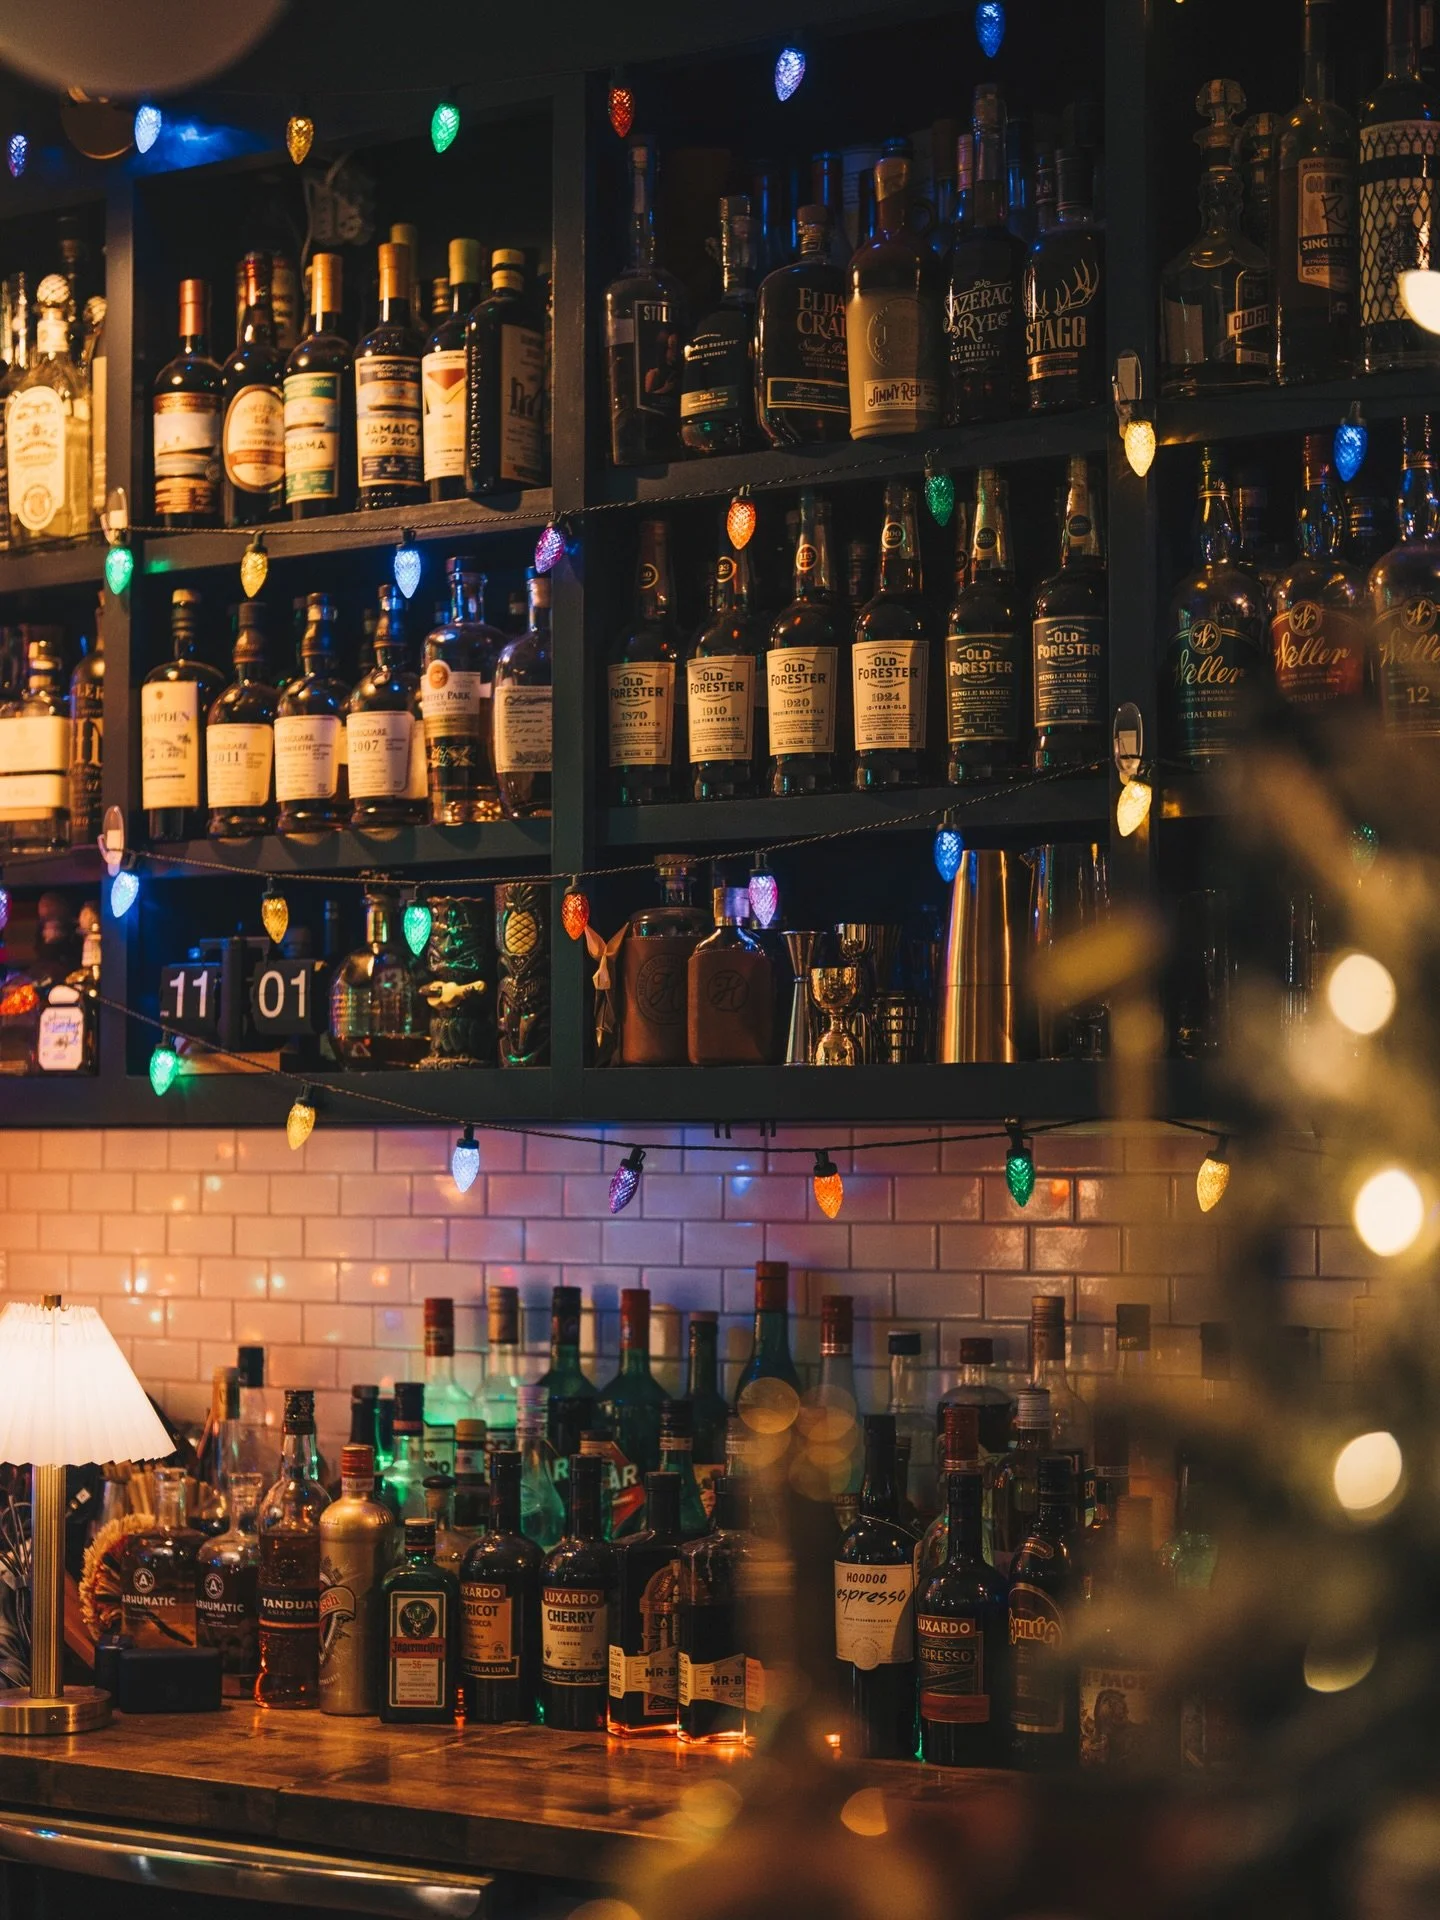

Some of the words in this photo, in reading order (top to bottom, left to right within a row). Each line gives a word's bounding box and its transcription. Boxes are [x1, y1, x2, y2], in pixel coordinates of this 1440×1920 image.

[1302, 238, 1340, 251] SINGLE
[958, 312, 1001, 343] RYE
[1026, 316, 1087, 355] STAGG
[868, 383, 901, 407] JIMMY
[900, 382, 921, 401] RED
[391, 436, 417, 448] 2015
[1054, 631, 1079, 643] OLD
[966, 648, 992, 661] OLD
[1038, 643, 1101, 660] FORESTER
[1274, 631, 1351, 672] Weller
[784, 663, 805, 673] OLD
[874, 657, 897, 667] OLD
[1173, 649, 1245, 688] Weller
[858, 667, 919, 681] FORESTER
[950, 661, 1013, 677] FORESTER
[623, 677, 644, 687] OLD
[703, 672, 723, 682] OLD
[771, 673, 826, 687] FORESTER
[609, 686, 665, 701] FORESTER
[690, 682, 745, 695] FORESTER
[951, 689, 978, 698] SINGLE
[1406, 686, 1430, 703] 12
[447, 690, 472, 701] PARK
[871, 692, 900, 703] 1924
[783, 698, 810, 708] 1920
[621, 711, 648, 721] 1870
[702, 706, 727, 716] 1910
[169, 970, 208, 1018] 11
[258, 969, 306, 1018] 01
[846, 1572, 888, 1584] HOODOO
[121, 1594, 177, 1607] ARHUMATIC
[544, 1591, 600, 1605] LUXARDO
[836, 1588, 907, 1615] espresso
[547, 1609, 597, 1624] CHERRY
[917, 1616, 971, 1634] LUXARDO
[411, 1660, 422, 1669] 56
